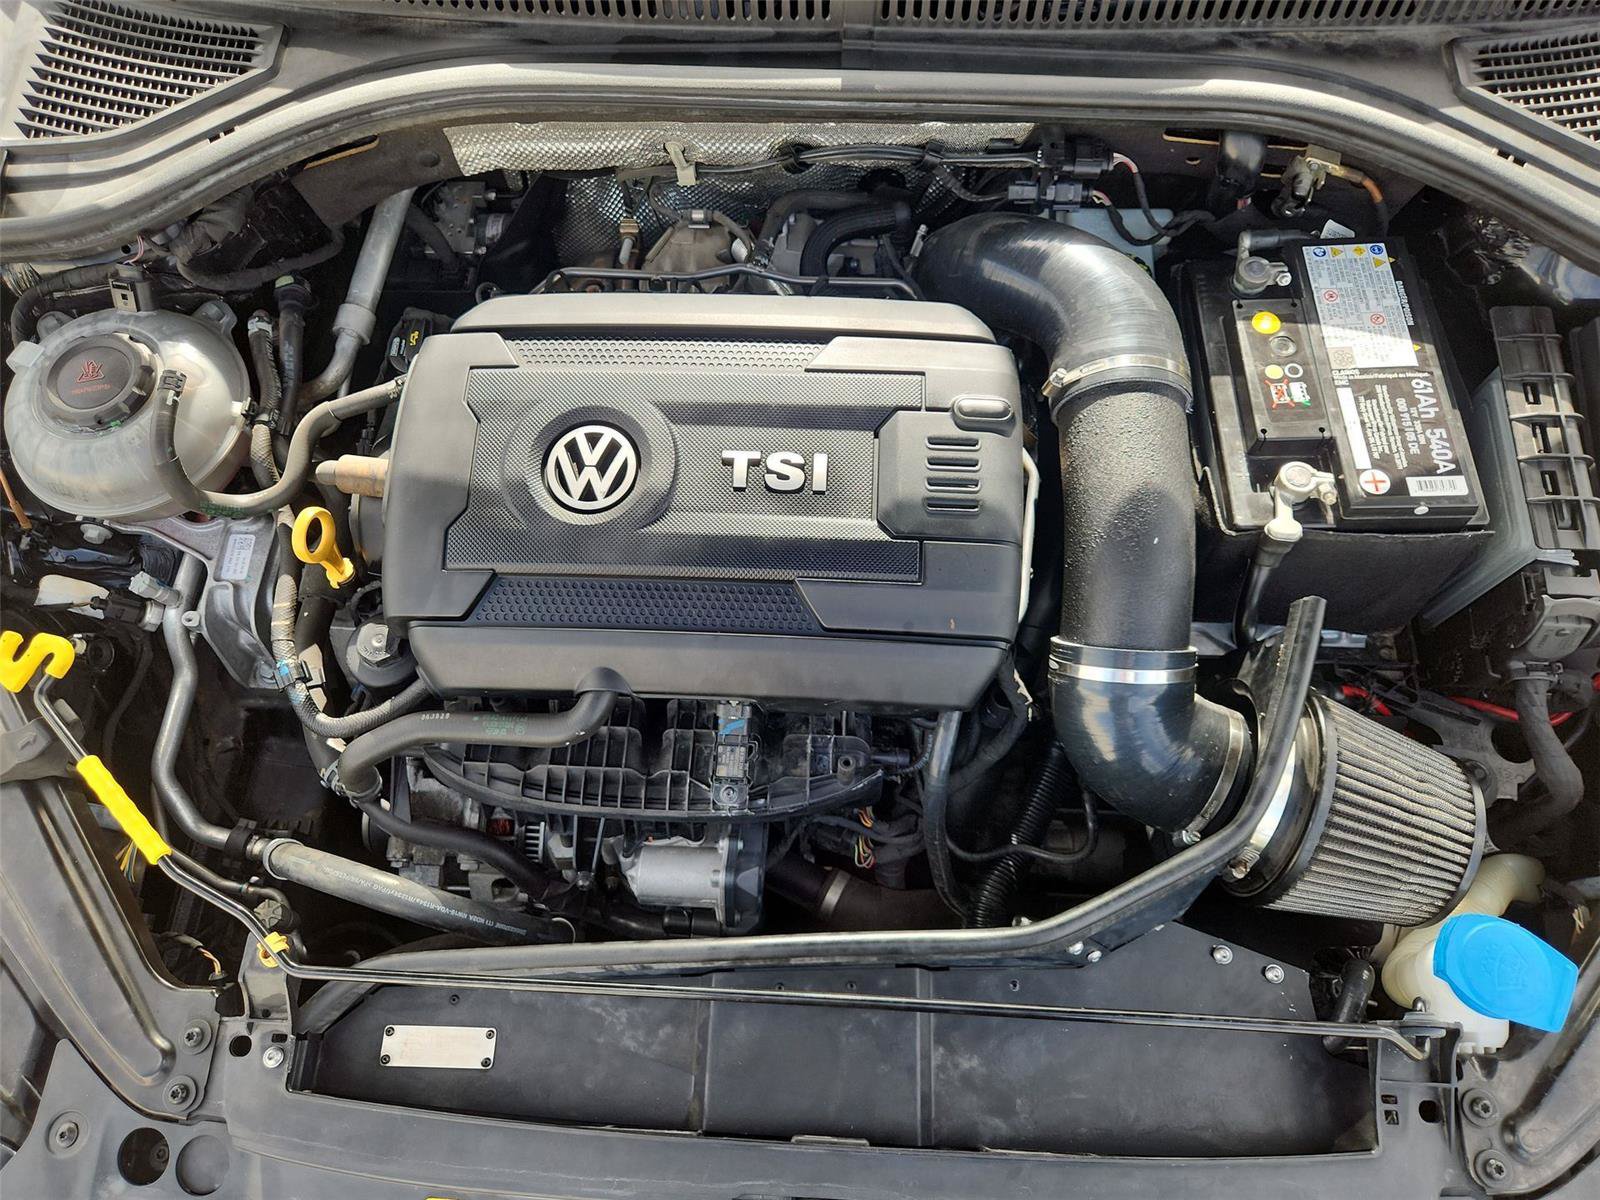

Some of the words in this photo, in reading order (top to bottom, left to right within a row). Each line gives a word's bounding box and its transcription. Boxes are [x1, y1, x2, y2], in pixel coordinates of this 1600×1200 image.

[1395, 280, 1415, 326] DANGER/POISON
[1411, 378, 1440, 419] 61Ah
[546, 424, 638, 512] VW
[1408, 442, 1420, 455] DE
[1425, 428, 1457, 475] 540A
[721, 449, 829, 494] TSI
